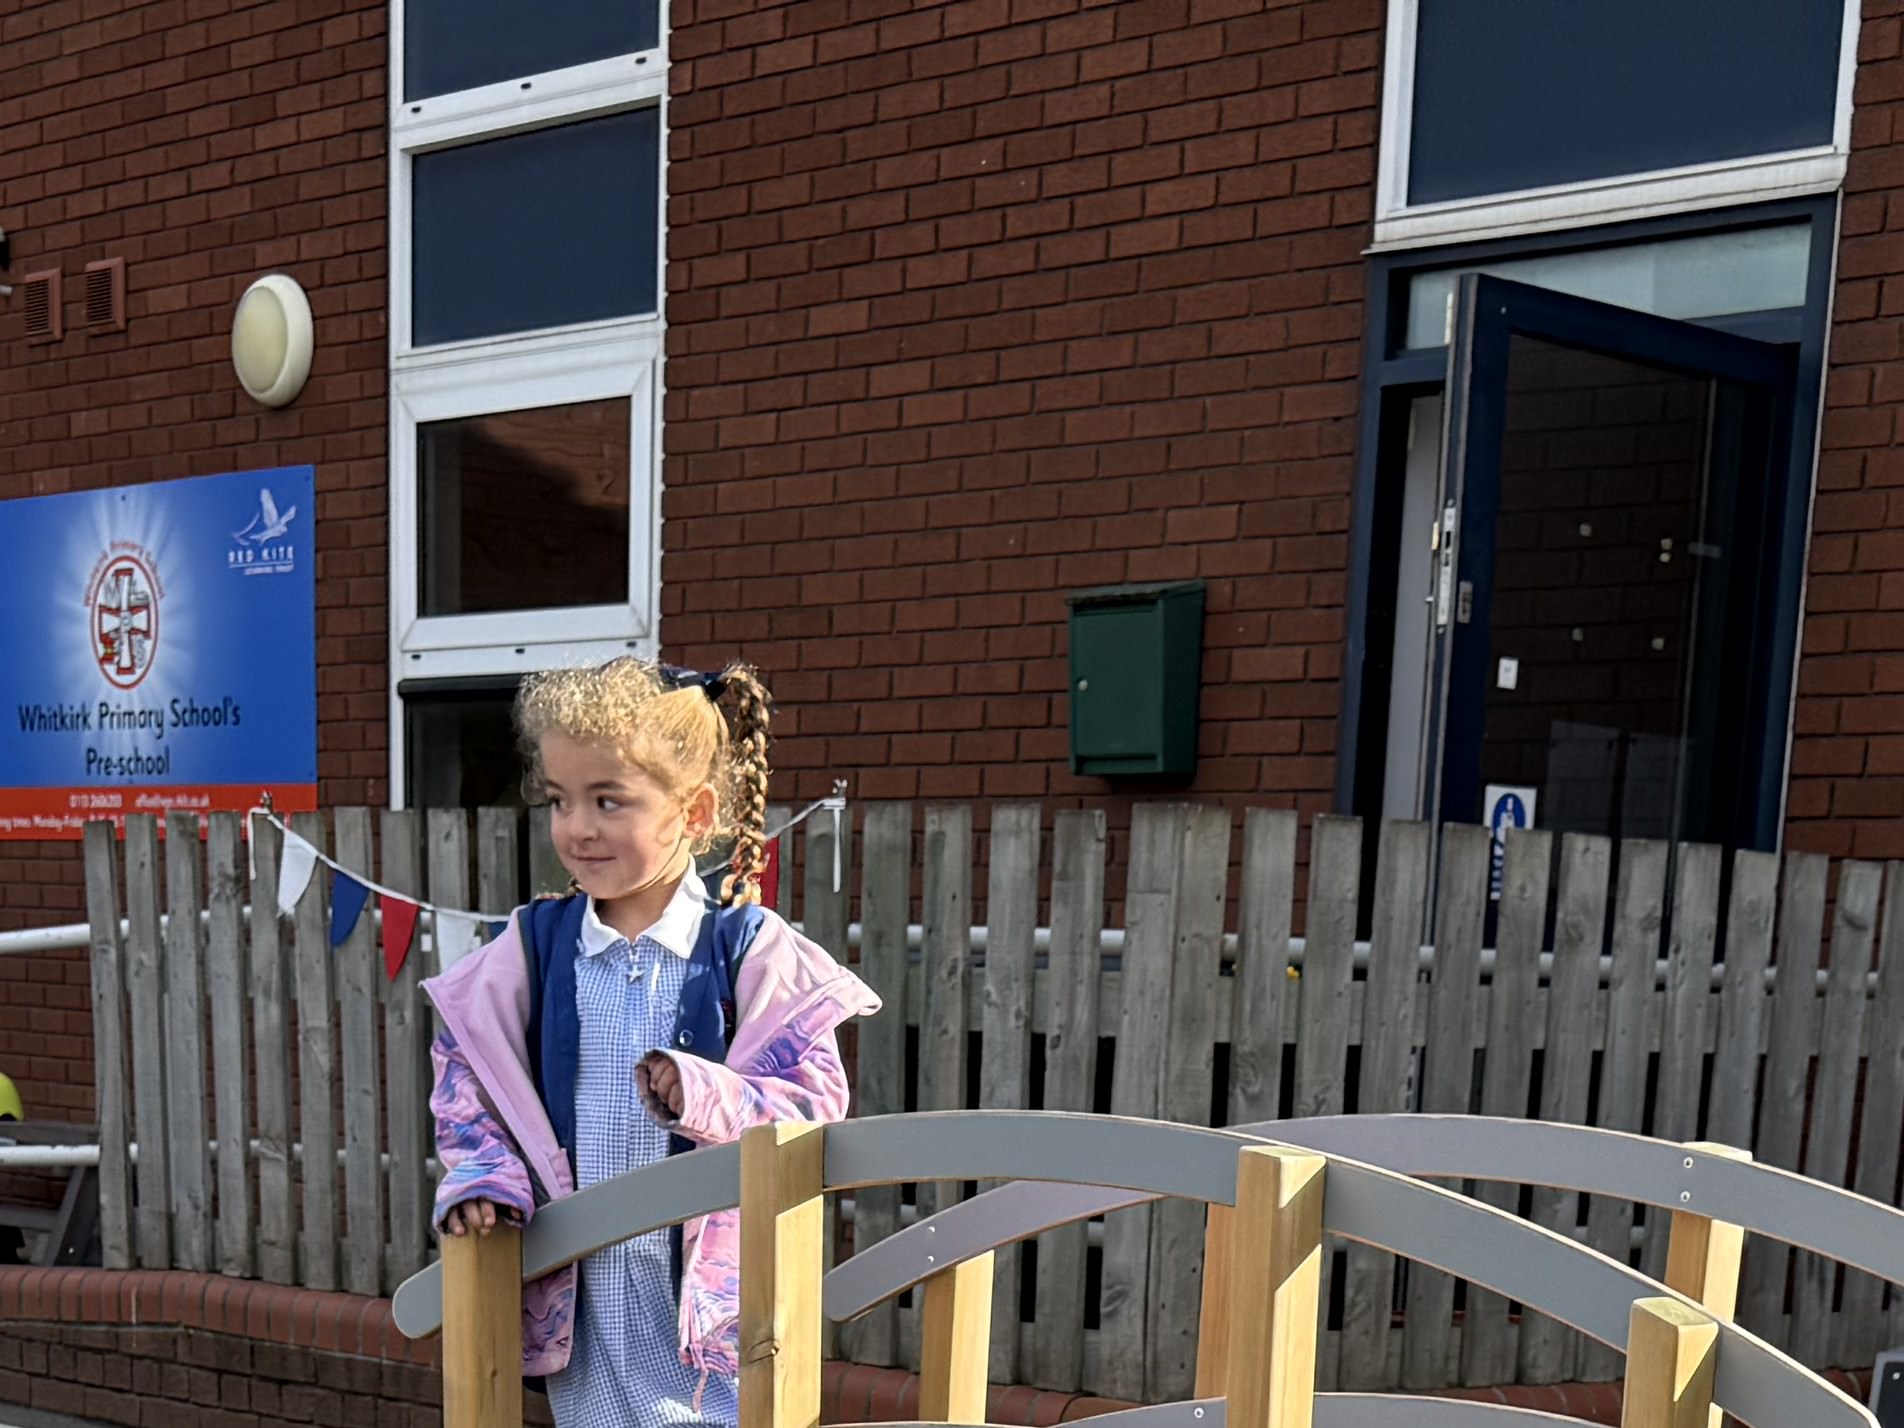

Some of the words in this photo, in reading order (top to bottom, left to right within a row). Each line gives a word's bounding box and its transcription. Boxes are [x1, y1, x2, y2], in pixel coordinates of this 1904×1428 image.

[18, 702, 92, 732] Whitkirk
[98, 701, 164, 740] Primary
[170, 697, 241, 728] School's
[86, 746, 170, 776] Pre-school
